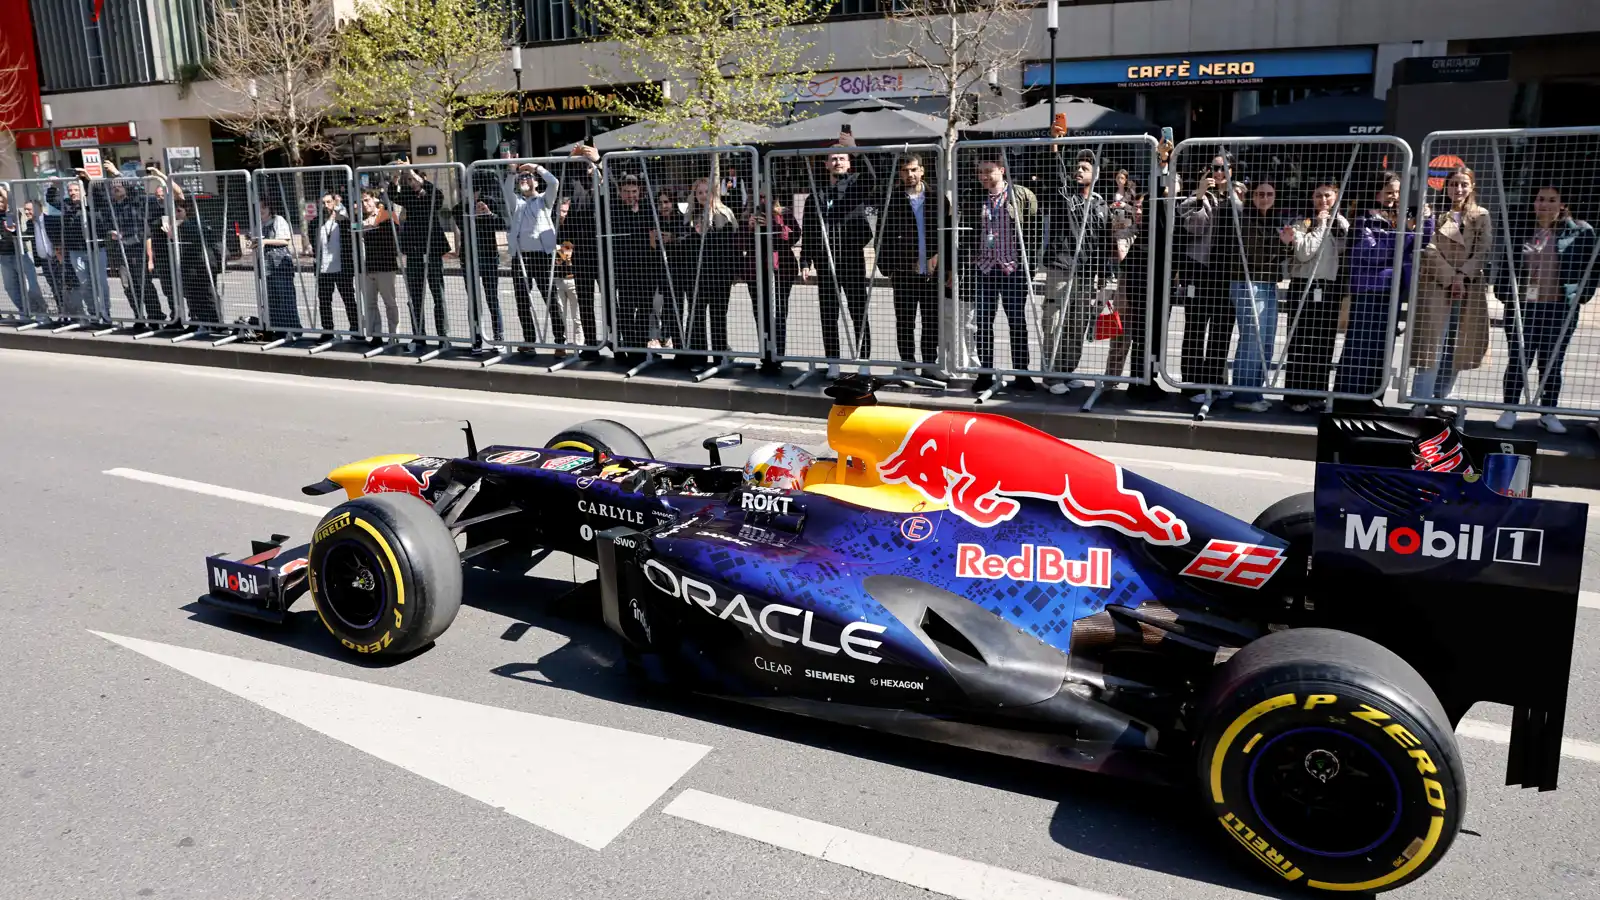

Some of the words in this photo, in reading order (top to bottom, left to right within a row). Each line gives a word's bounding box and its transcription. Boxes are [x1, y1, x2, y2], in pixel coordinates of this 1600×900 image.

[1127, 60, 1191, 79] CAFFÈ
[1198, 61, 1255, 76] NERO
[1011, 130, 1040, 138] ITALIAN
[577, 499, 645, 525] CARLYLE
[741, 492, 794, 514] ROKT
[313, 511, 352, 544] PIRELLI
[1344, 513, 1485, 561] Mobil
[1509, 531, 1526, 561] 1
[957, 545, 1032, 580] Red
[1037, 547, 1111, 586] Bull
[1180, 539, 1287, 590] 22
[213, 566, 259, 595] Mobil
[393, 607, 403, 629] P
[643, 558, 888, 664] ORACLE
[340, 630, 394, 654] ZERO
[754, 656, 793, 676] CLEAR
[804, 669, 856, 684] SIEMENS
[880, 679, 924, 690] HEXAGON
[1302, 694, 1338, 710] P
[1350, 703, 1446, 811] ZERO
[1218, 811, 1305, 882] PIRELLI
